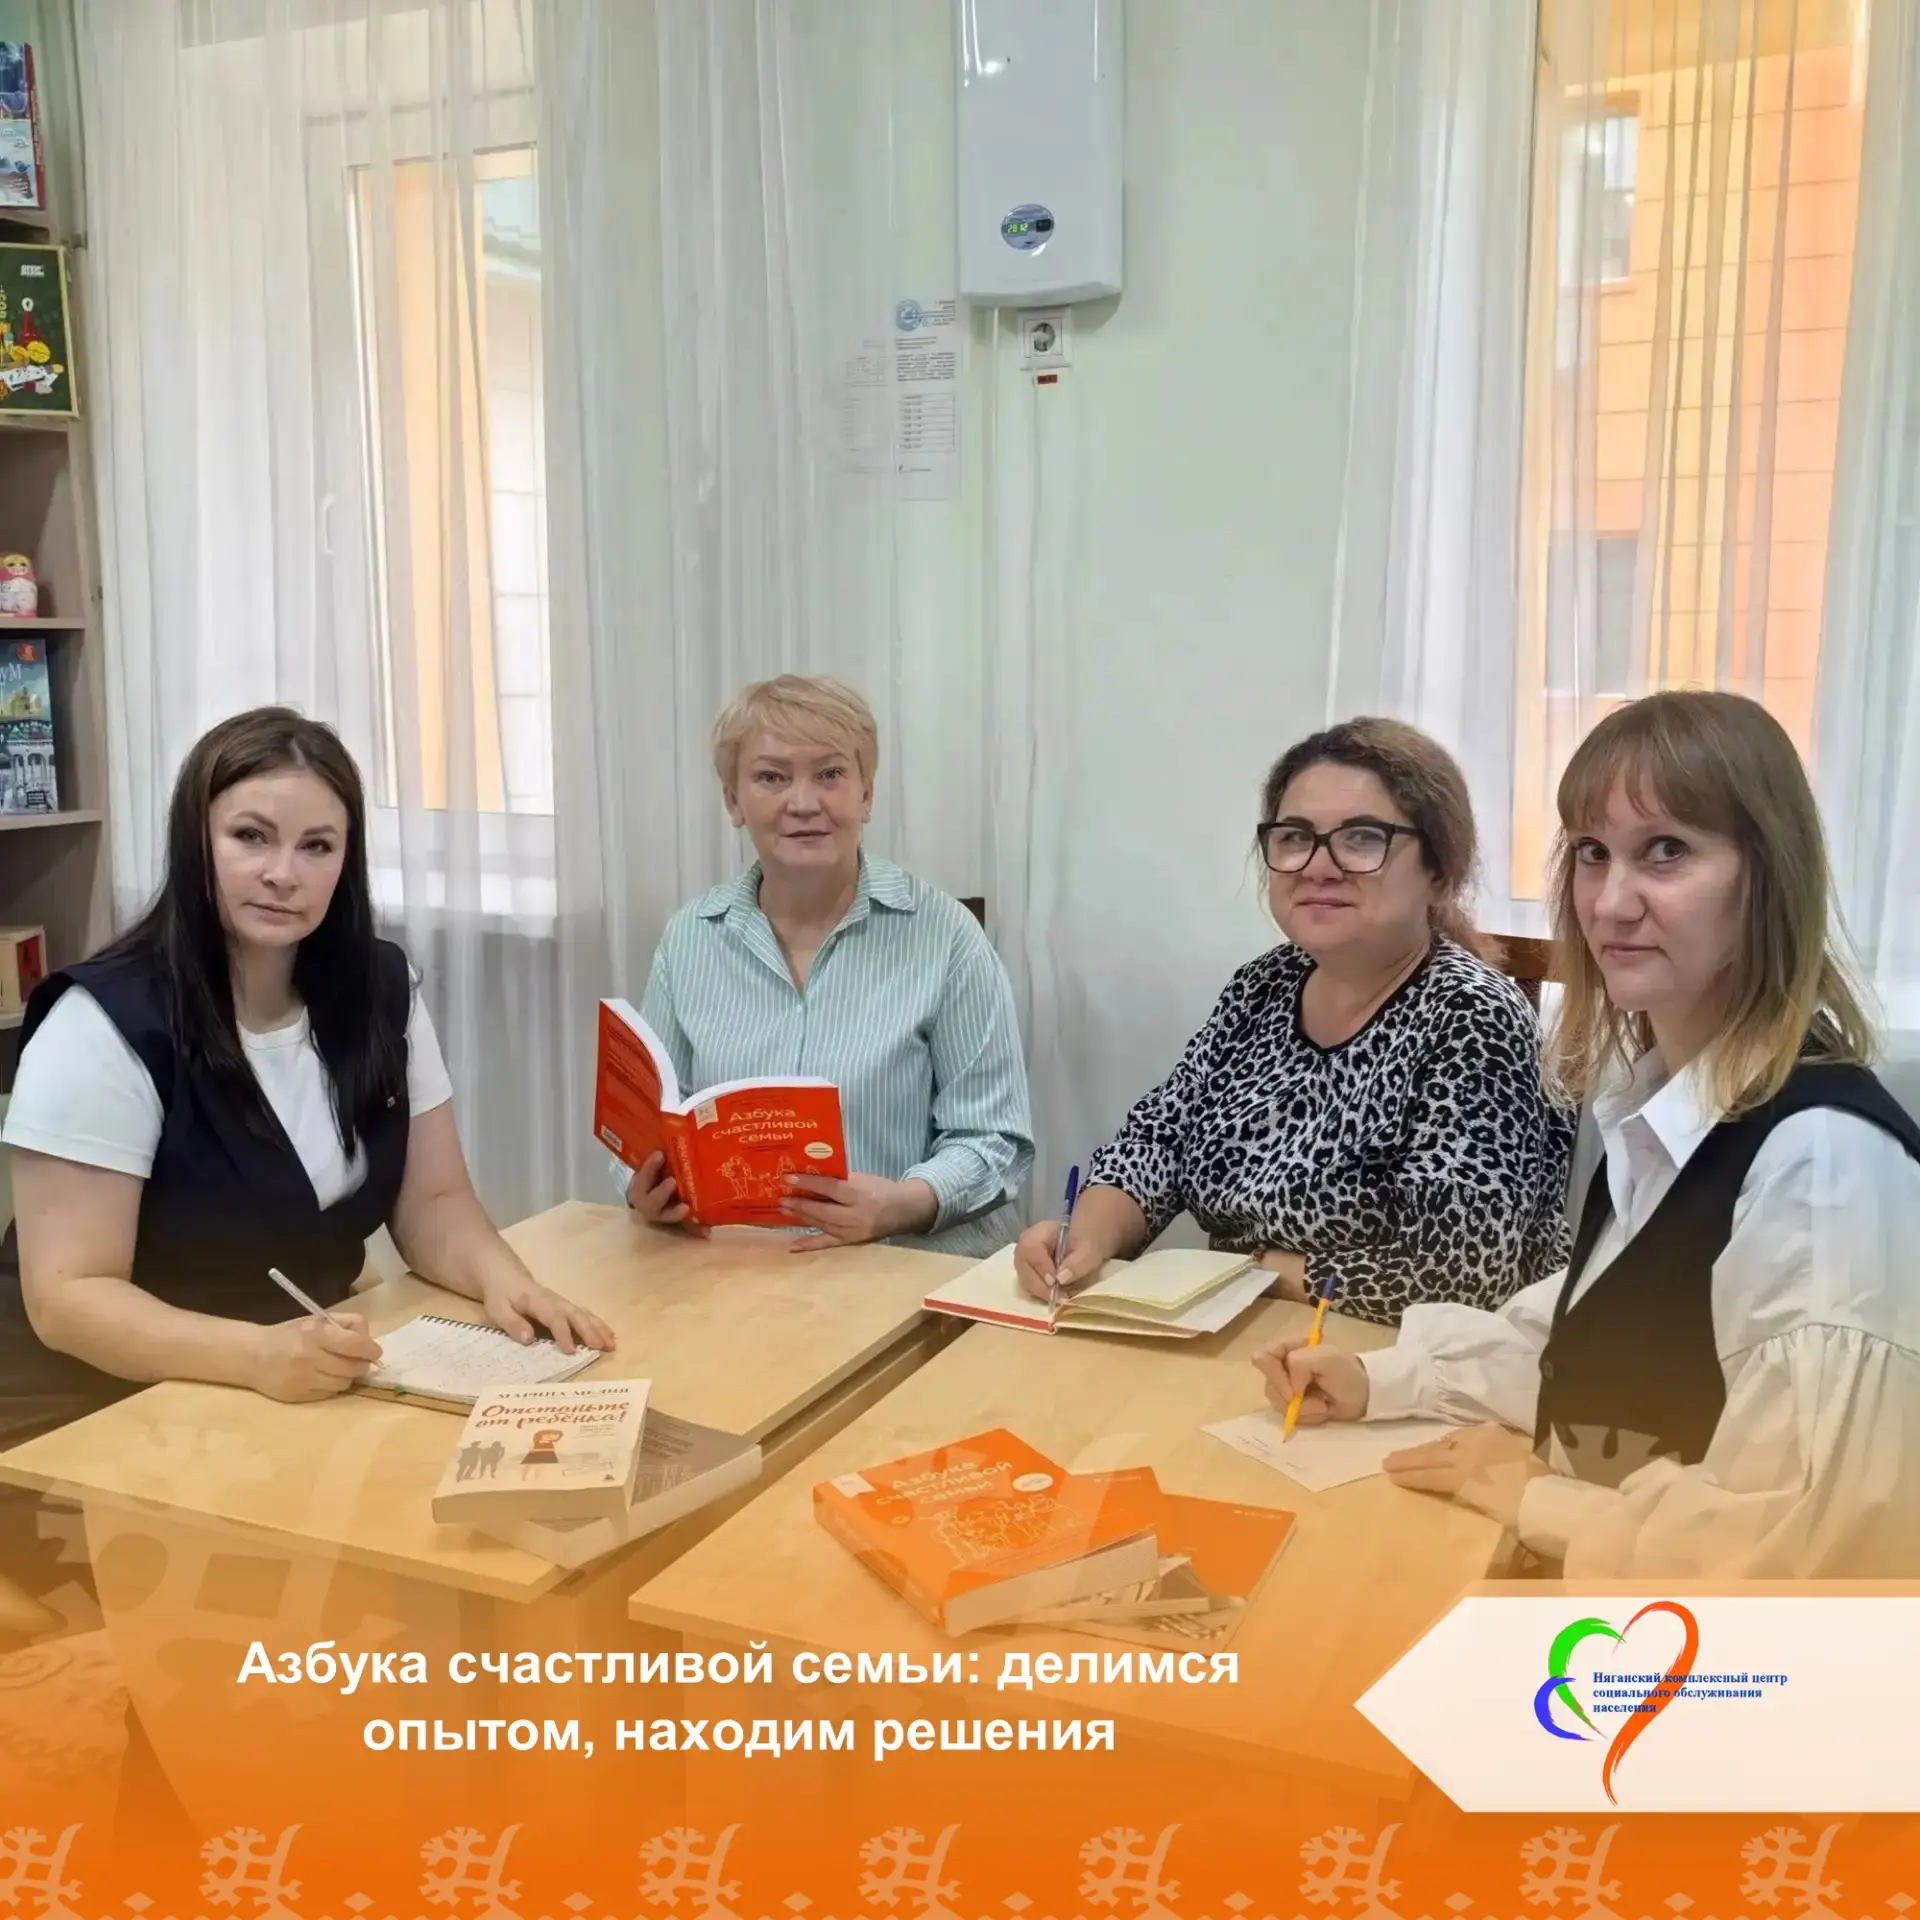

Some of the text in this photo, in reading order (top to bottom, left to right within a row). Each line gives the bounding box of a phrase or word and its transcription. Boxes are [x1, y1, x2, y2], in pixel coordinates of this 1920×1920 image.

[730, 1108, 796, 1122] Азбука
[712, 1119, 818, 1140] счастливой
[738, 1132, 794, 1144] семьи
[481, 1402, 630, 1418] Отстаньте
[475, 1411, 628, 1430] от ребёнка!
